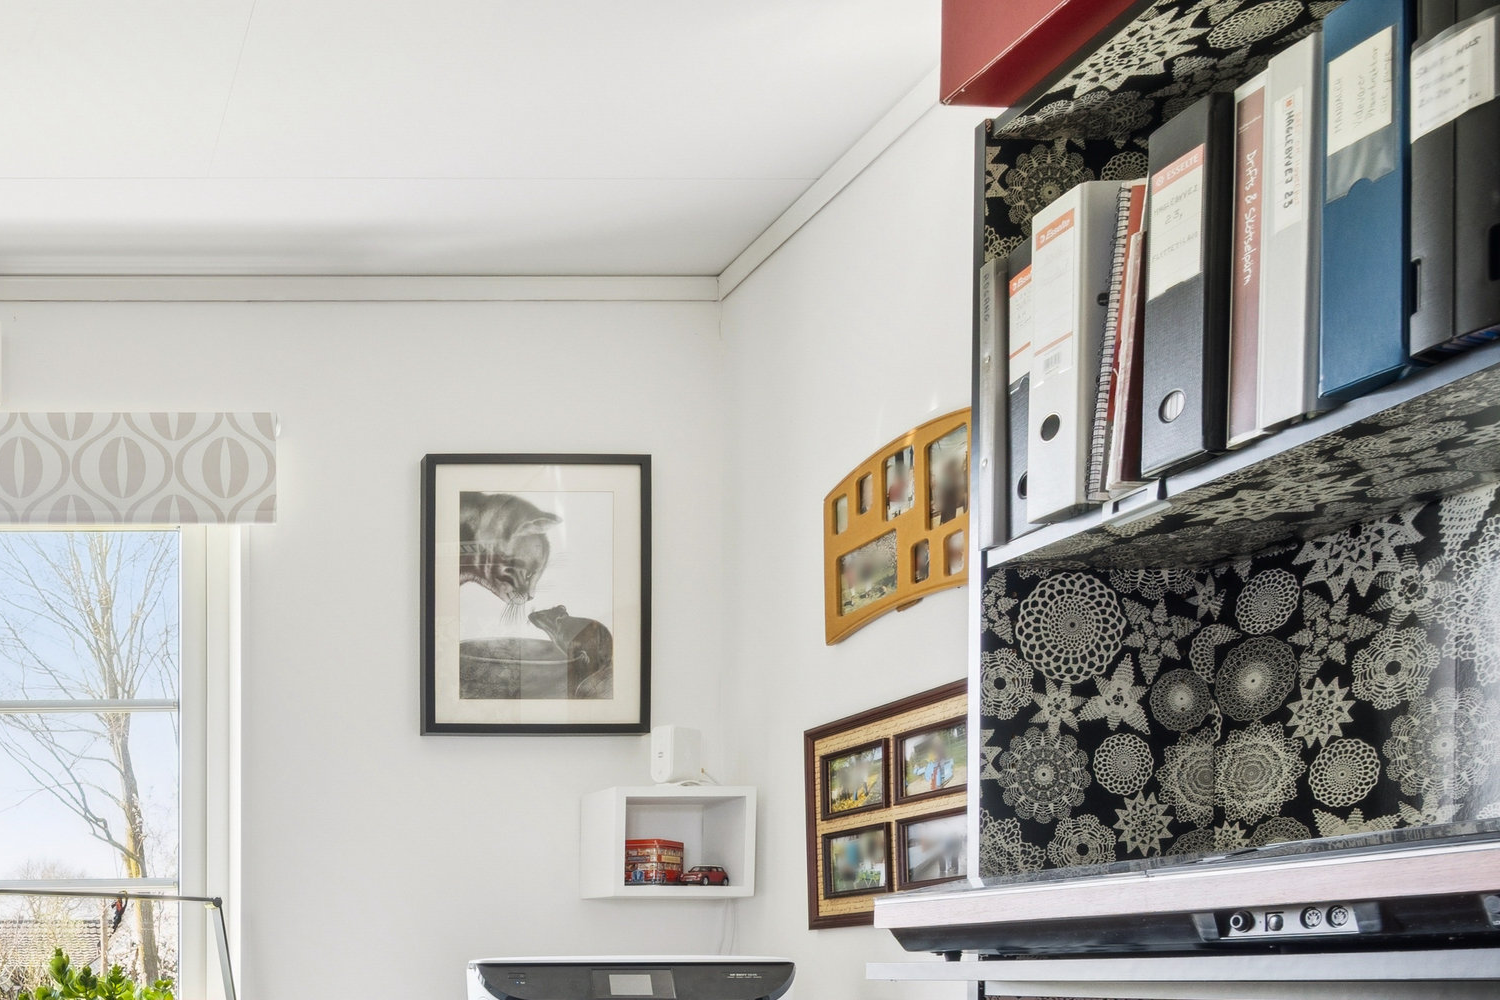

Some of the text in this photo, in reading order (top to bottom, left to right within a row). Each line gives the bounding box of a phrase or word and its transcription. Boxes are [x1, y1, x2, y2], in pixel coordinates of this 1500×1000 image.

[1166, 153, 1199, 181] ESSELTE
[1244, 149, 1258, 192] Drifts
[1245, 192, 1257, 205] &
[1045, 218, 1070, 242] Esselte
